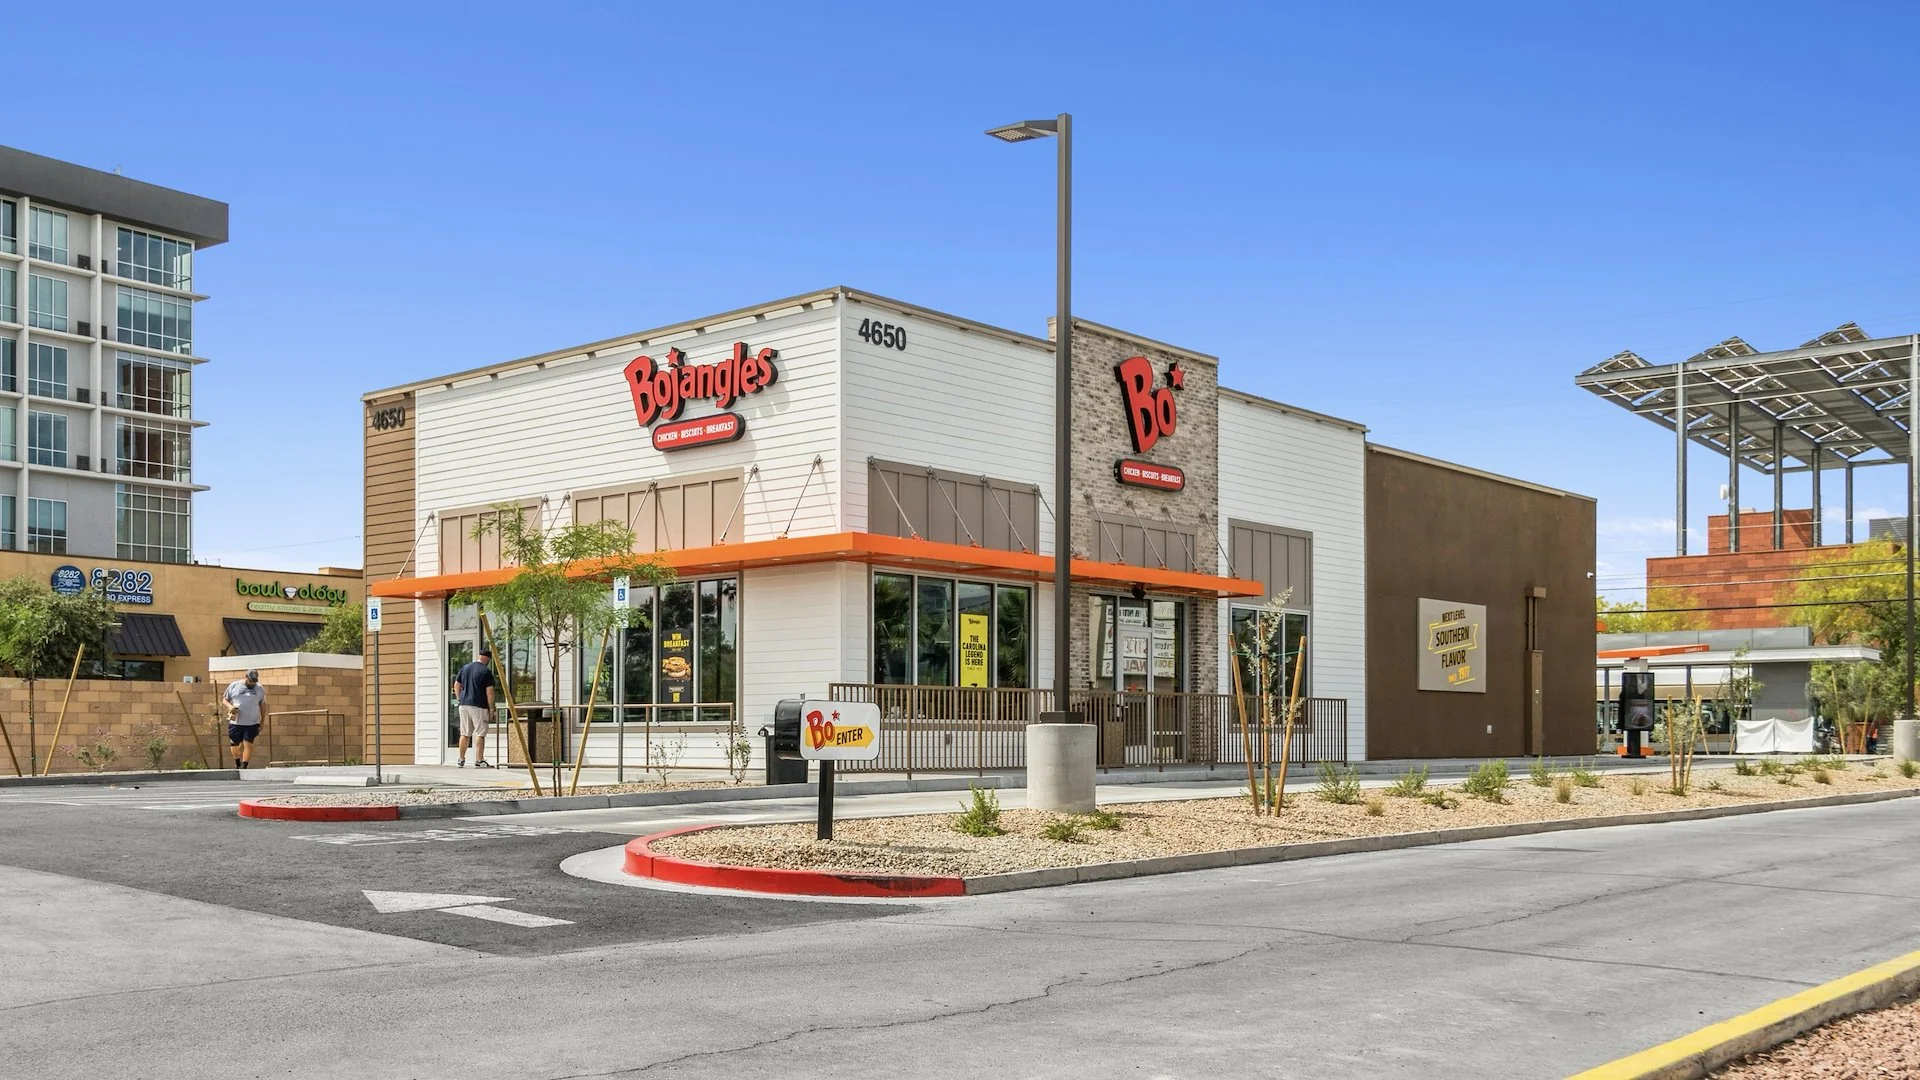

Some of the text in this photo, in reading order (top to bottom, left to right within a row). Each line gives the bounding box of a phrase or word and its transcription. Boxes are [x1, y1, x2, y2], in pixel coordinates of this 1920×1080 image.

[859, 318, 907, 351] 4650
[623, 341, 778, 427] Bojangles
[372, 406, 406, 432] 4650
[657, 421, 734, 442] CHICKEN BISCUITS BREAKFAST
[58, 569, 81, 579] 8282
[91, 567, 153, 594] 8282
[117, 594, 151, 603] EXPRESS
[250, 603, 275, 611] Healthy
[277, 604, 300, 612] Kitchen
[308, 606, 324, 614] Juice
[1442, 609, 1466, 622] NEXT LEVEL
[970, 635, 979, 643] THE
[1436, 626, 1470, 647] SOUTHERN
[663, 640, 690, 648] BREAKFAST
[962, 643, 986, 651] CAROLINA
[965, 651, 983, 659] LEGEND
[1441, 650, 1466, 669] FLAVOR
[965, 658, 983, 667] IS HERE
[588, 671, 610, 683] BSS
[806, 710, 863, 752] Bo ENTER
